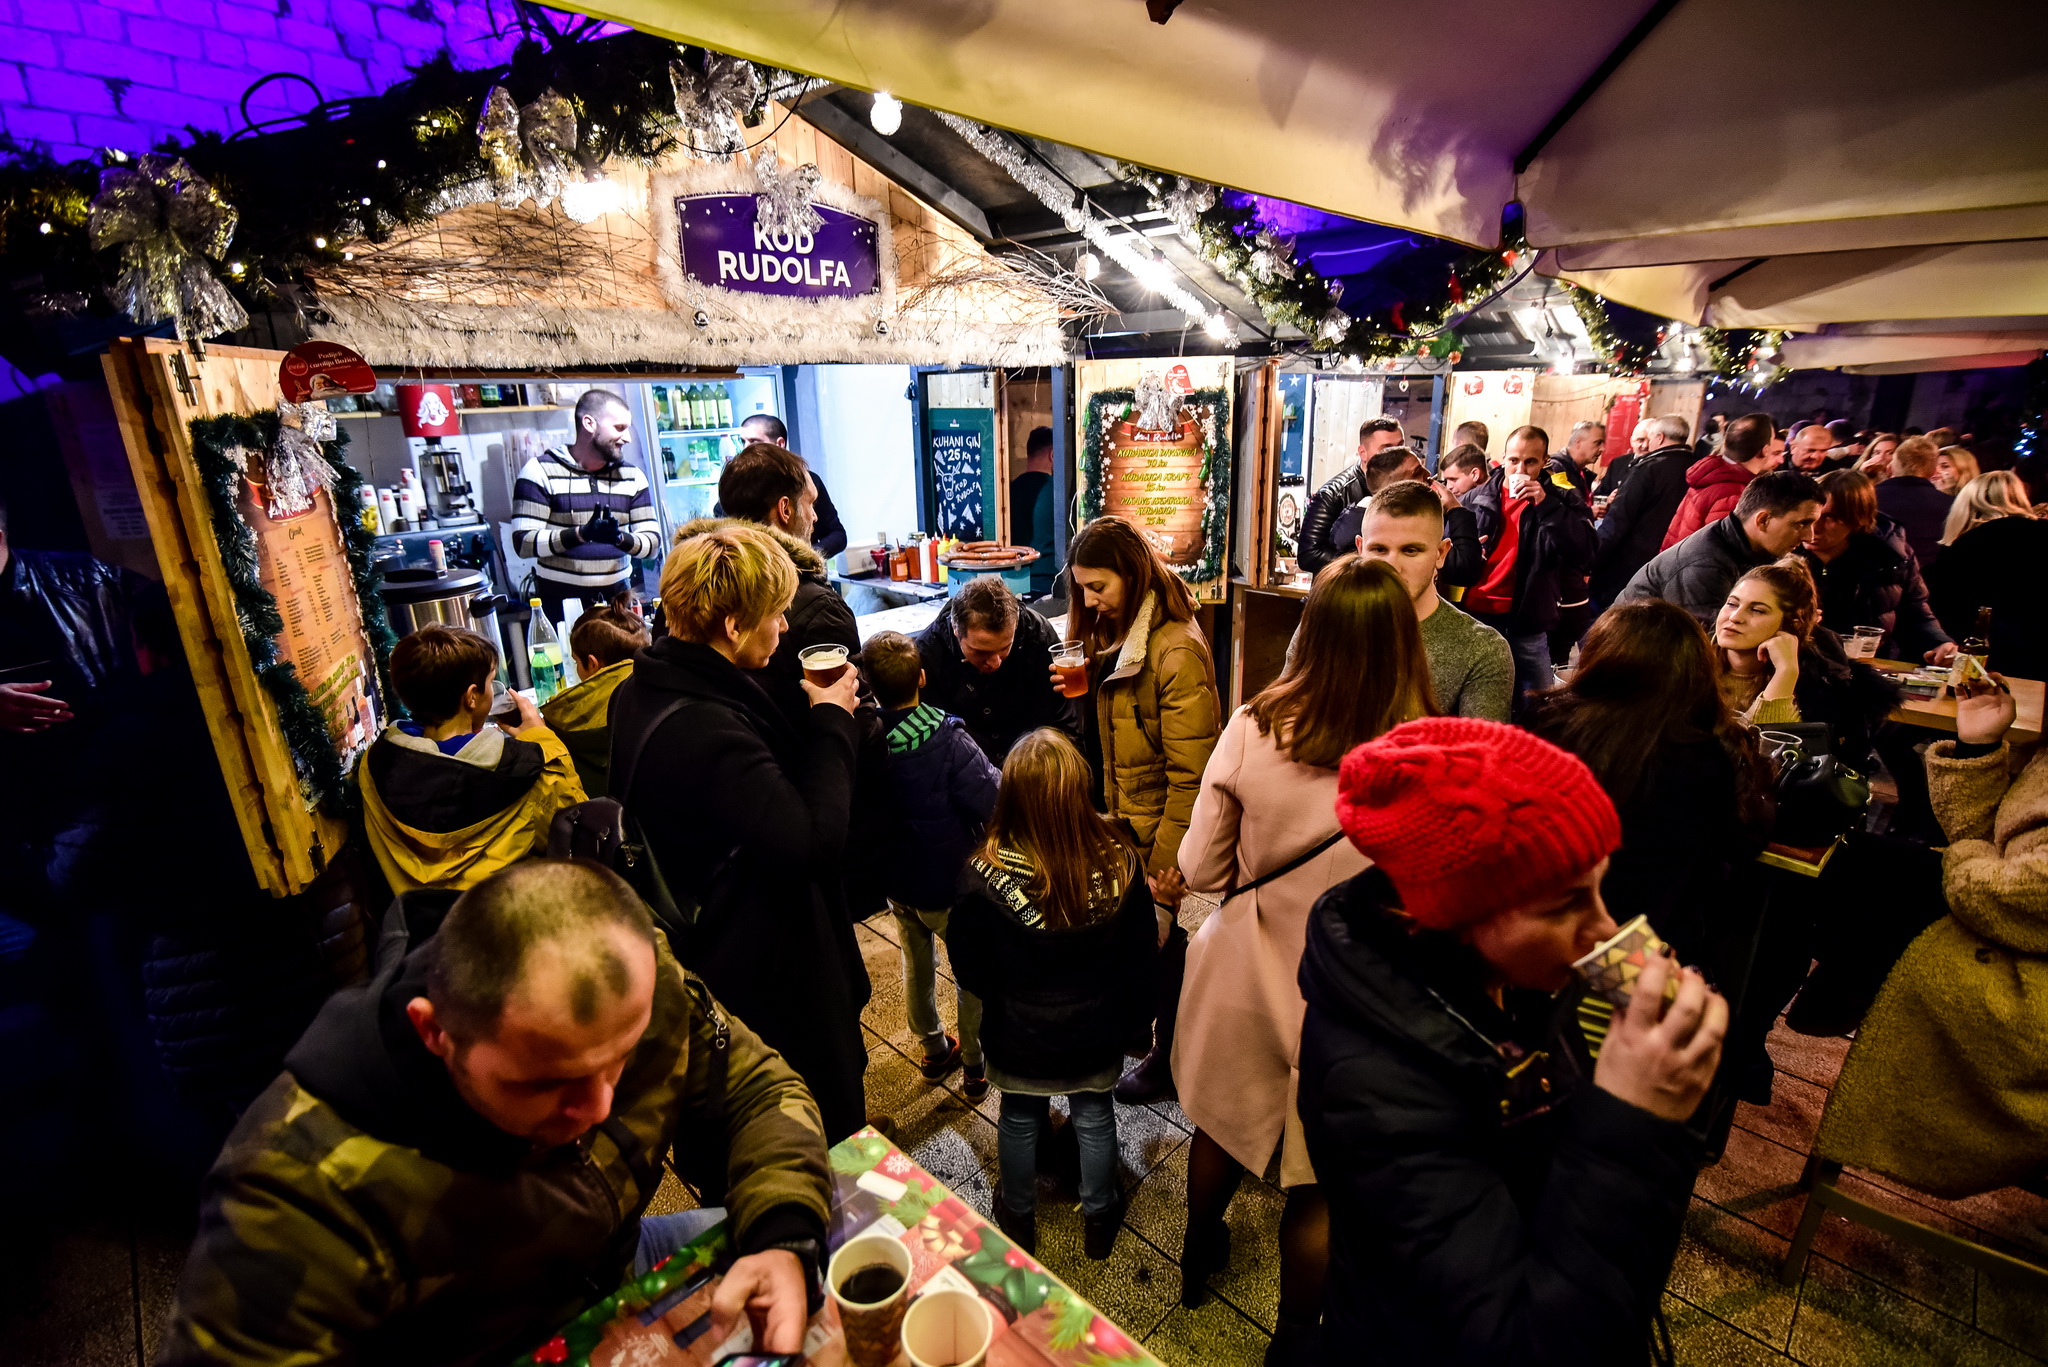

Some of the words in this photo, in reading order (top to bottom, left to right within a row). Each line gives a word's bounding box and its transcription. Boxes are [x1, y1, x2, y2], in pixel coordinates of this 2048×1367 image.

[754, 221, 814, 254] KOD
[718, 250, 851, 288] RUDOLFA
[933, 436, 963, 448] KUHANI
[966, 432, 981, 449] GIN
[948, 449, 961, 461] 25
[955, 479, 968, 492] KOD
